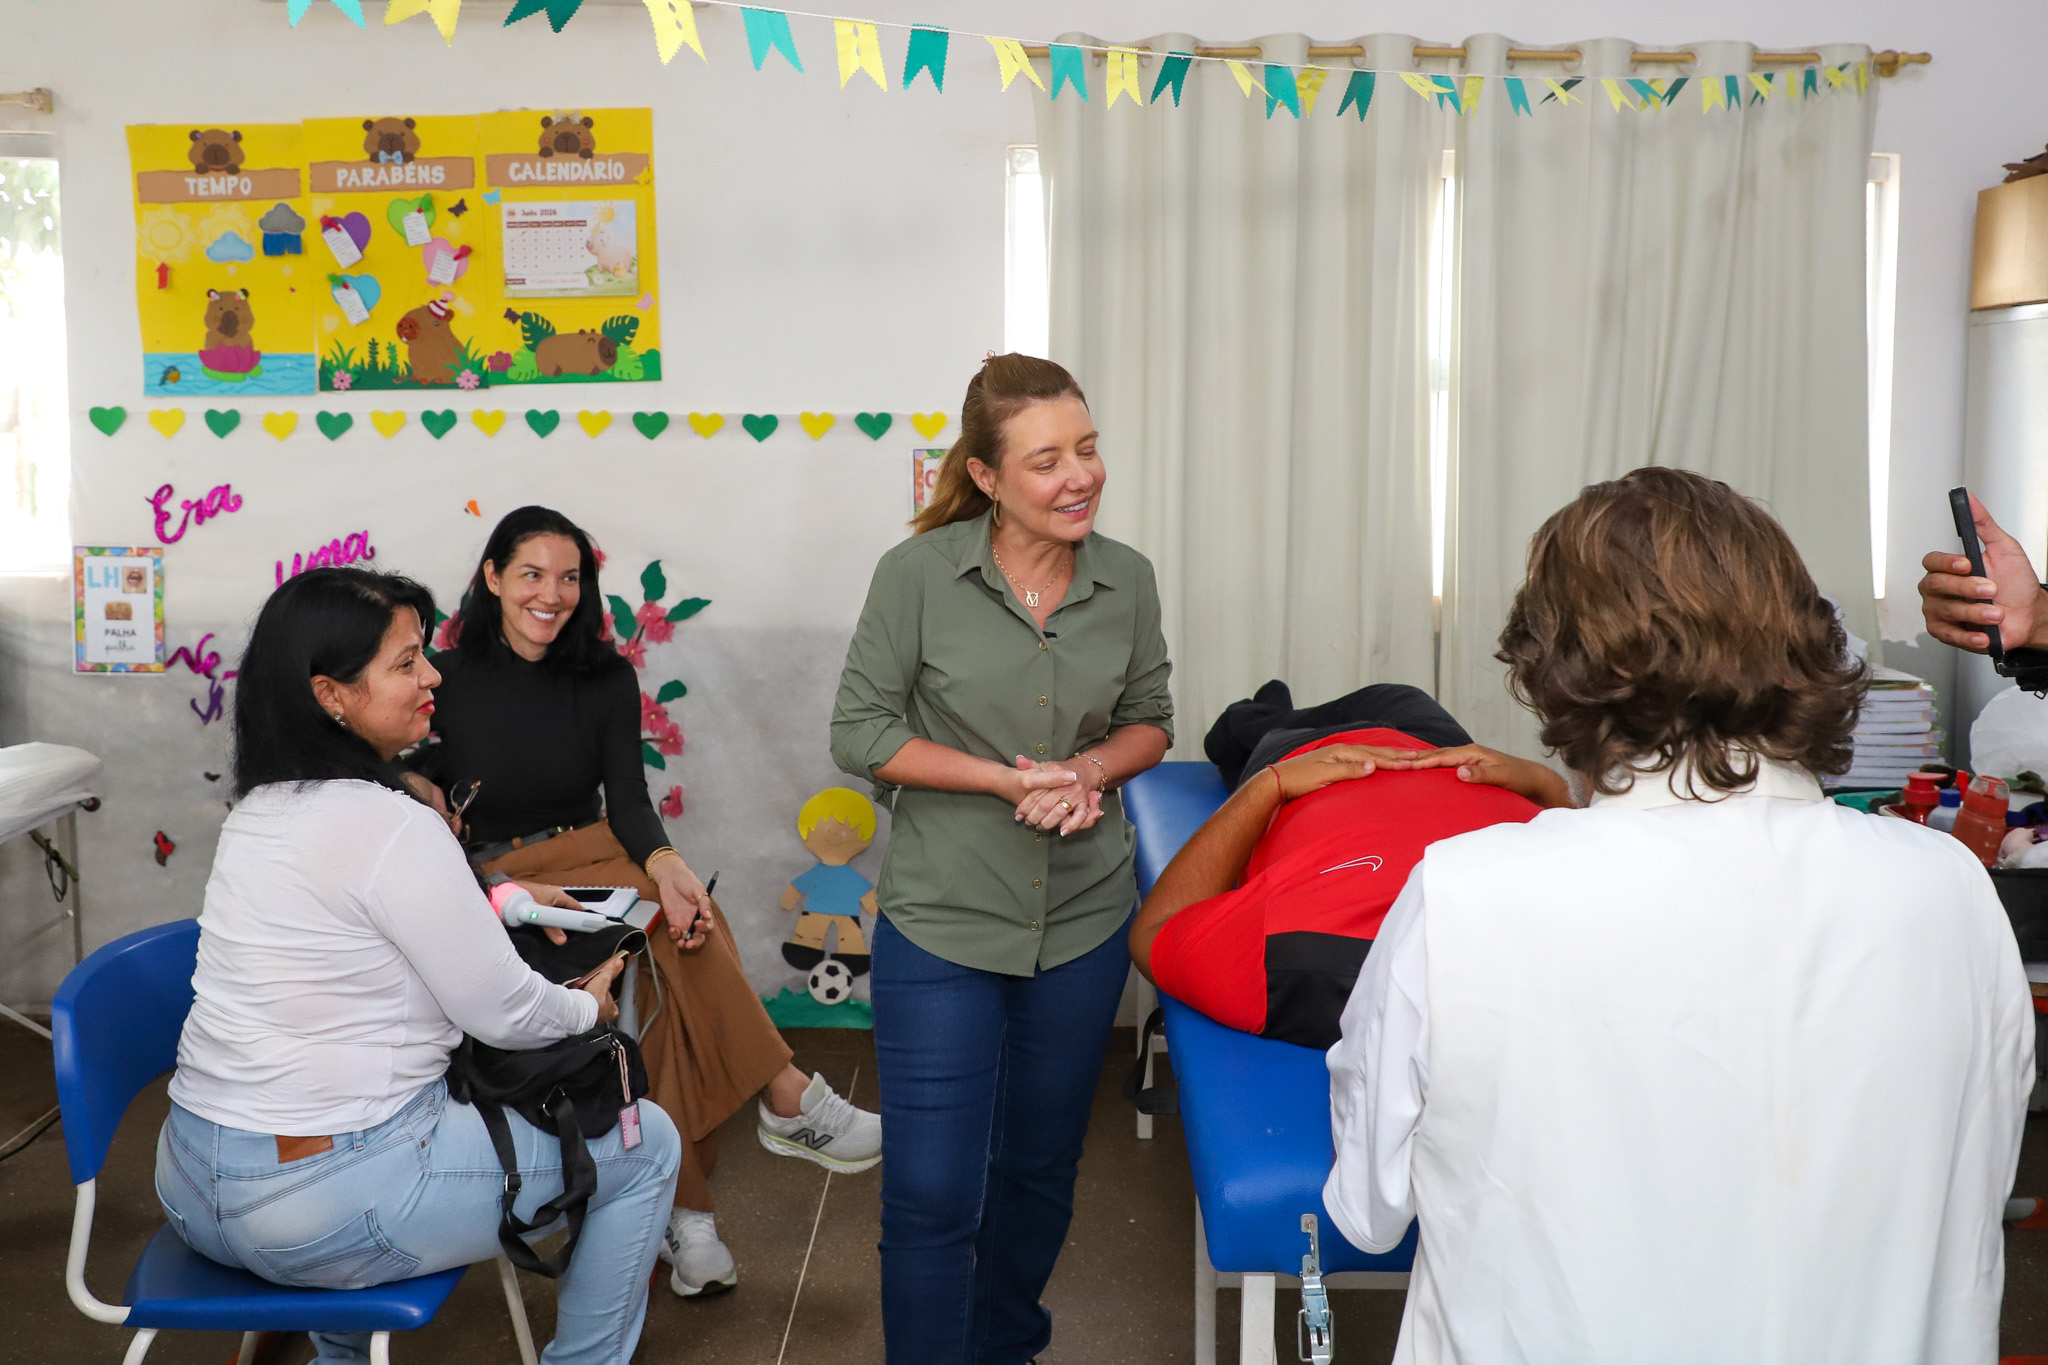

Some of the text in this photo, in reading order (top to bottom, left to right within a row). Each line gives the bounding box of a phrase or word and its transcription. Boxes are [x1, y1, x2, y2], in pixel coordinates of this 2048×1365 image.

[336, 161, 446, 188] PARABÉNS
[508, 158, 626, 182] CALENDÁRIO
[184, 176, 252, 196] TEMPO
[144, 483, 243, 545] Era
[88, 566, 119, 588] LH
[104, 628, 137, 636] PALHA
